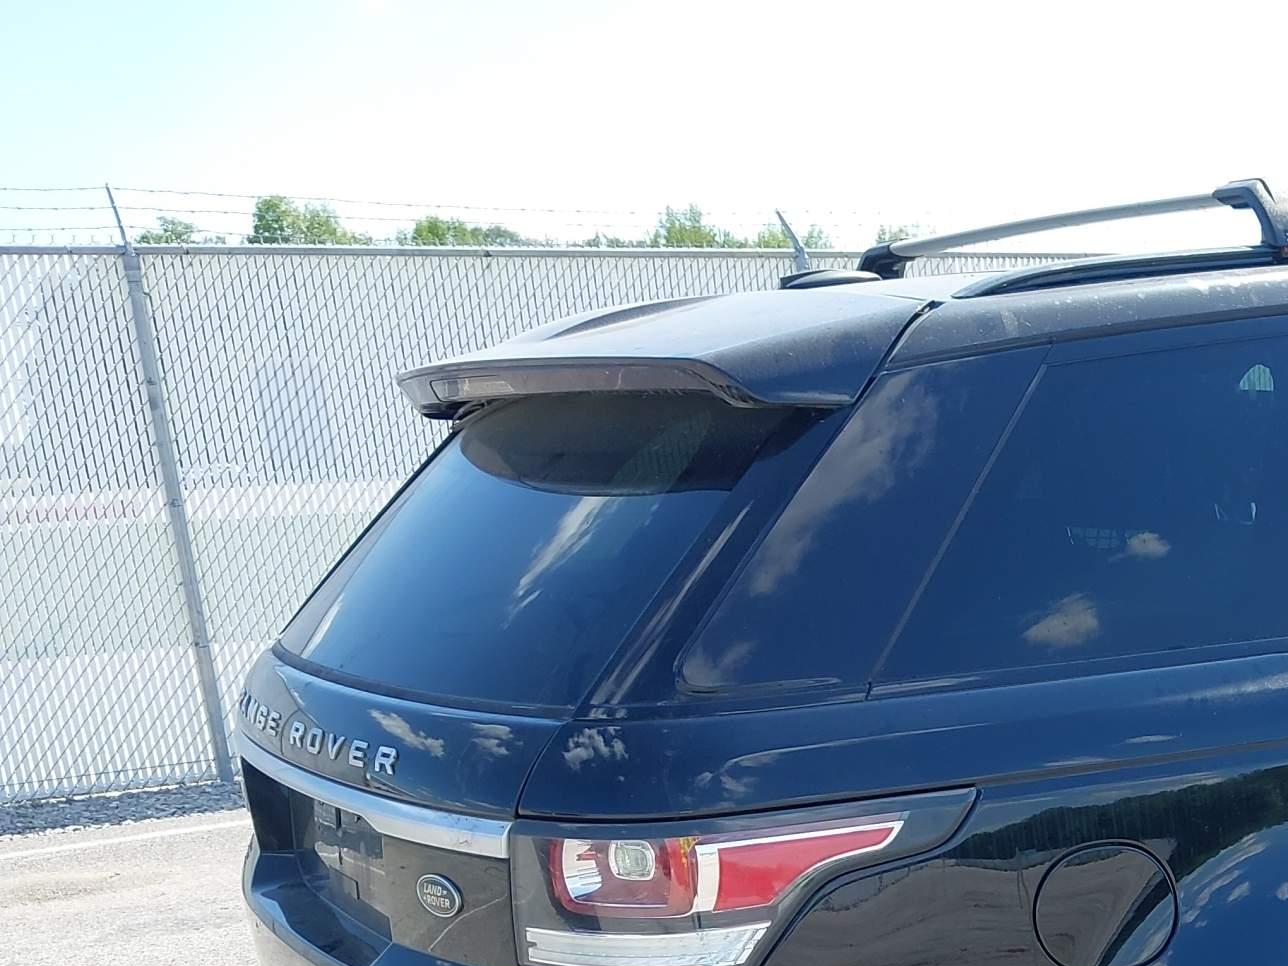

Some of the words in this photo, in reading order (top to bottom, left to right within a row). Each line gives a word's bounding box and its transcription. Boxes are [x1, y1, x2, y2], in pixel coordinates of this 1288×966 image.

[290, 720, 398, 775] ROVER
[423, 882, 442, 896] LAND
[427, 894, 451, 909] ROVER
